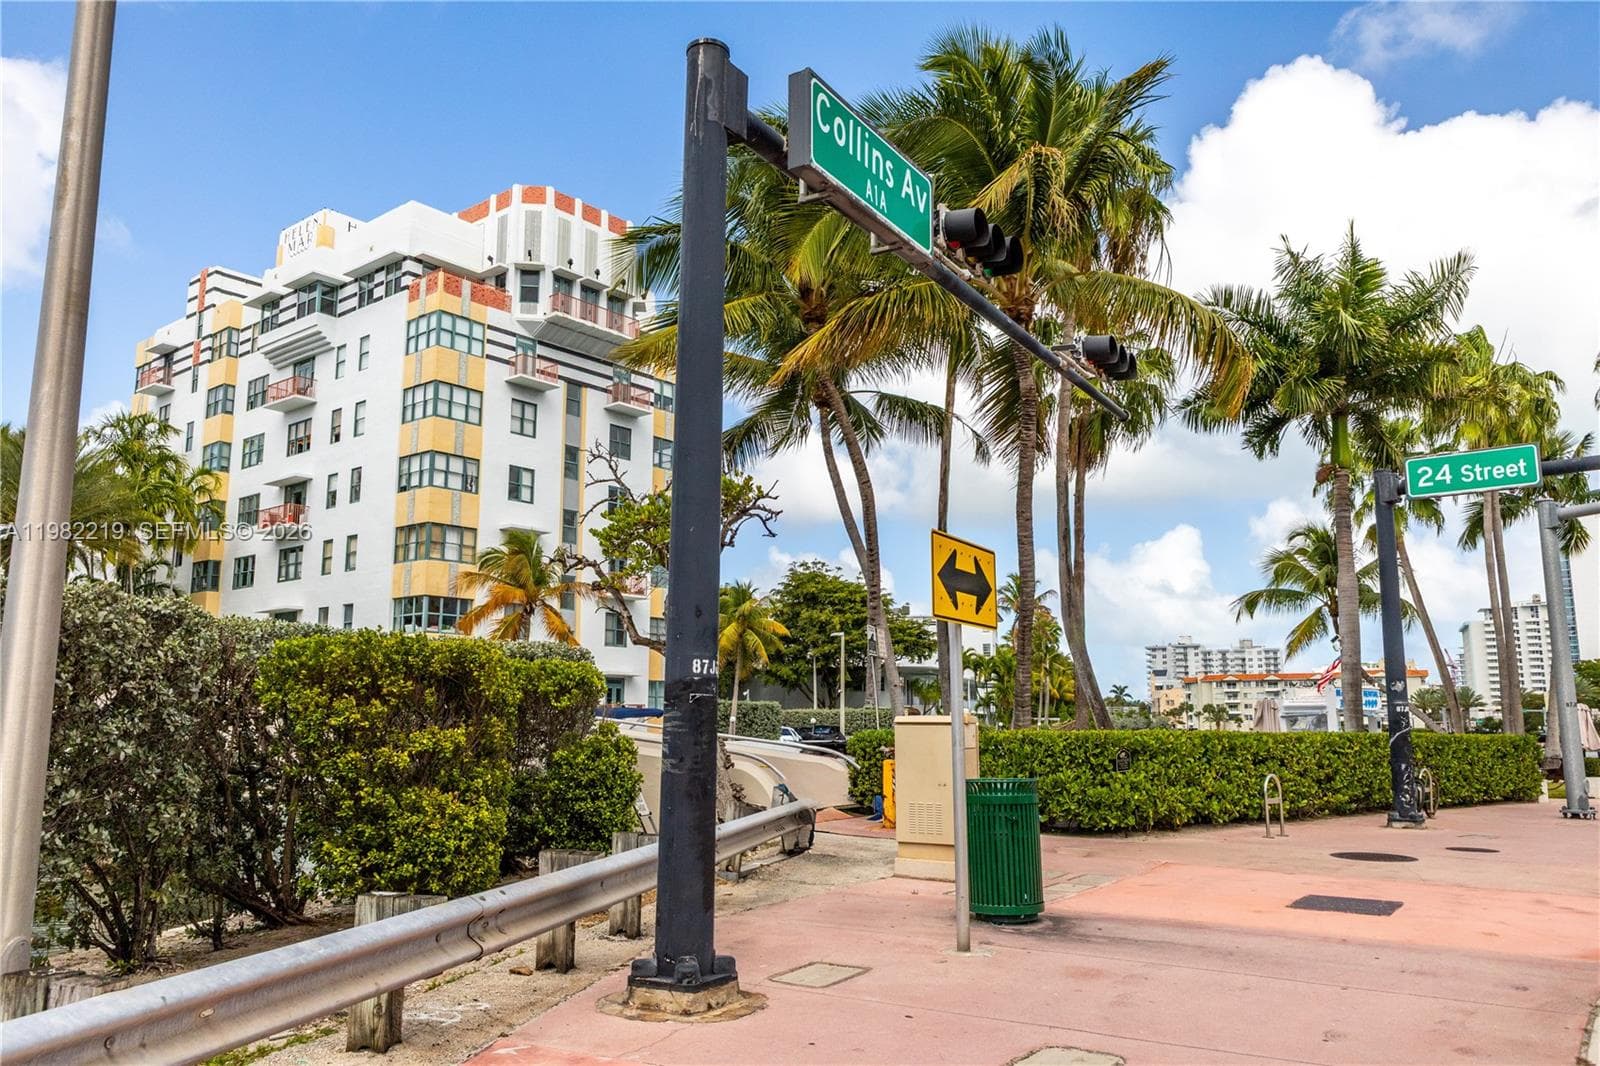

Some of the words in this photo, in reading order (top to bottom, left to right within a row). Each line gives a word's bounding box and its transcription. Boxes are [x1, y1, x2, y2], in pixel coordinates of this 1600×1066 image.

[816, 92, 894, 189] Collins
[901, 168, 928, 214] Av
[865, 179, 887, 214] A1A
[1416, 463, 1453, 488] 24
[1460, 458, 1528, 483] Street
